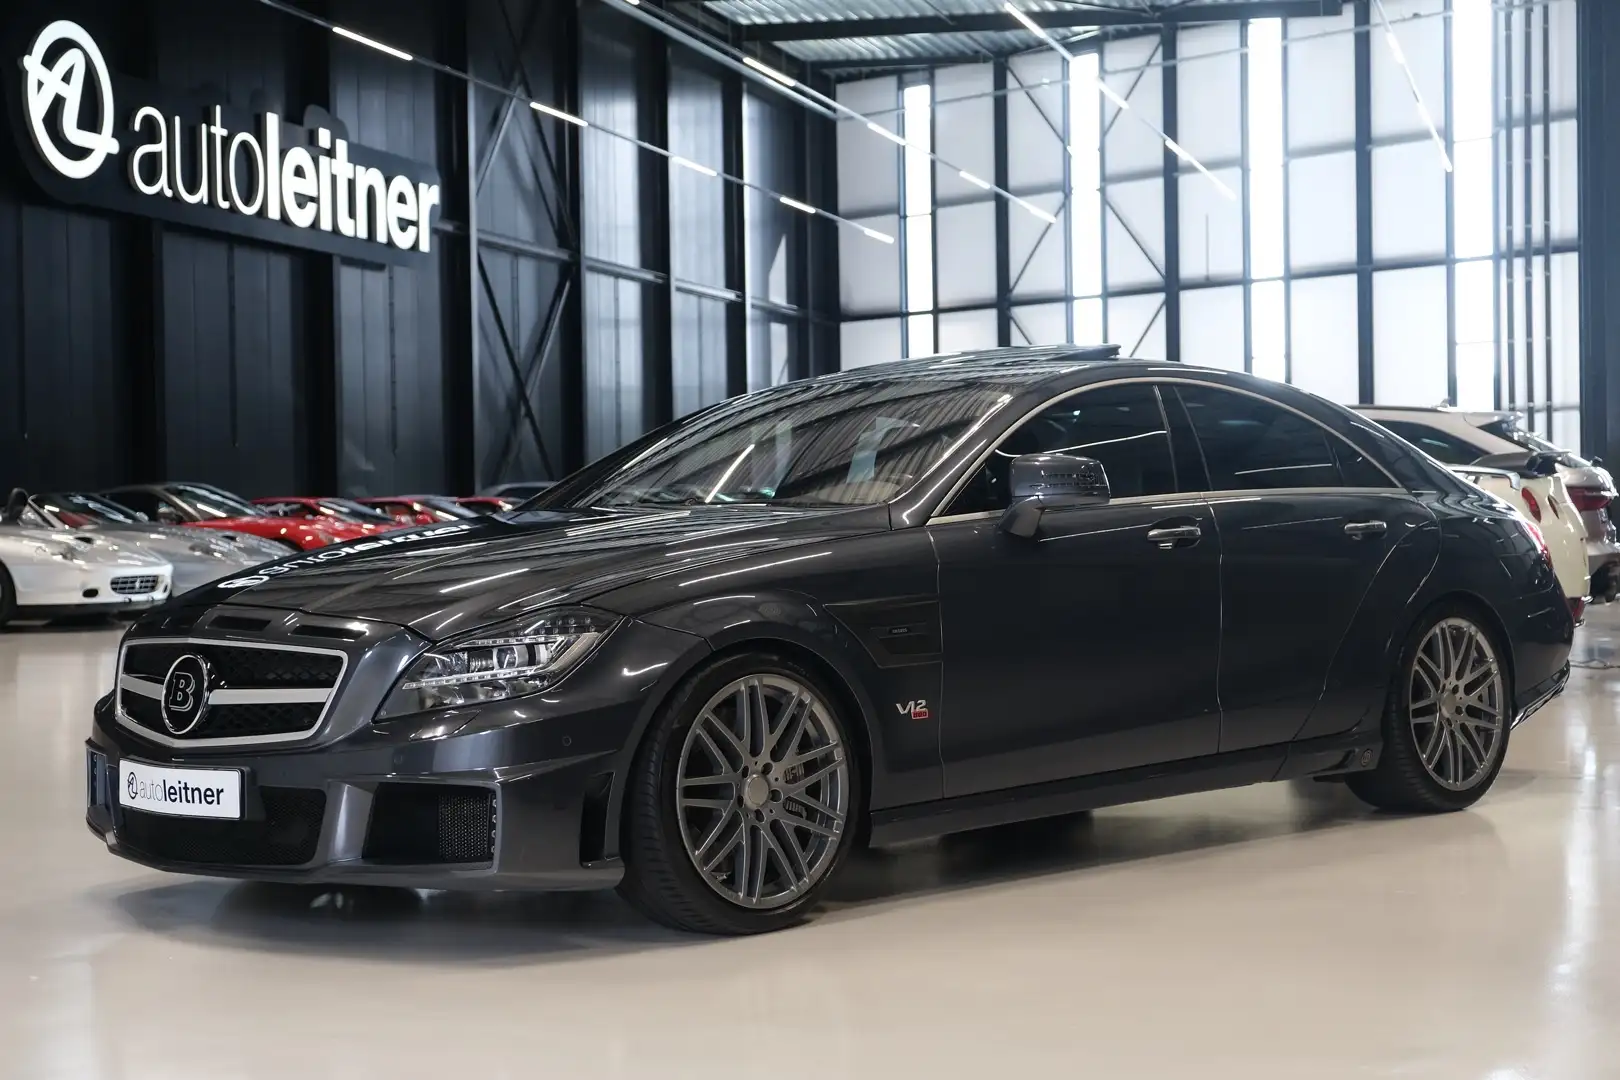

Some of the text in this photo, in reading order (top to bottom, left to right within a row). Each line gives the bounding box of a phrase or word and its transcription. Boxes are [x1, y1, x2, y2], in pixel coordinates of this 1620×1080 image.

[133, 104, 439, 253] autoleitner
[169, 671, 196, 712] B
[895, 699, 927, 715] V12
[139, 779, 224, 805] autoleitner
